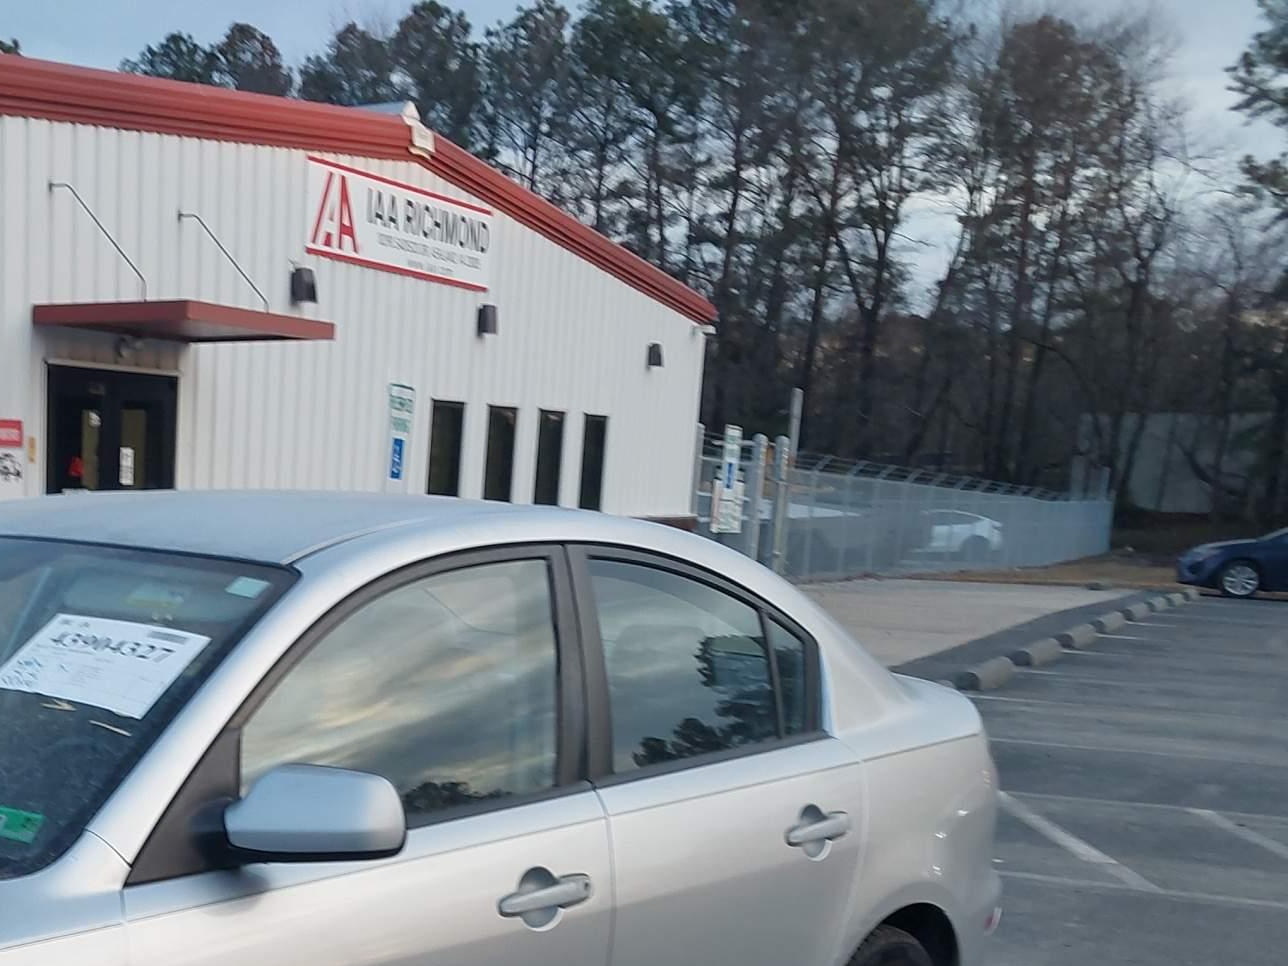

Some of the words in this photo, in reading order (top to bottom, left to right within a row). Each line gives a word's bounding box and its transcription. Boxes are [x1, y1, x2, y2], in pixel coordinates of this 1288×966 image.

[367, 188, 399, 231] IAA
[405, 199, 490, 253] RICHMOND
[50, 631, 175, 663] 43904327
